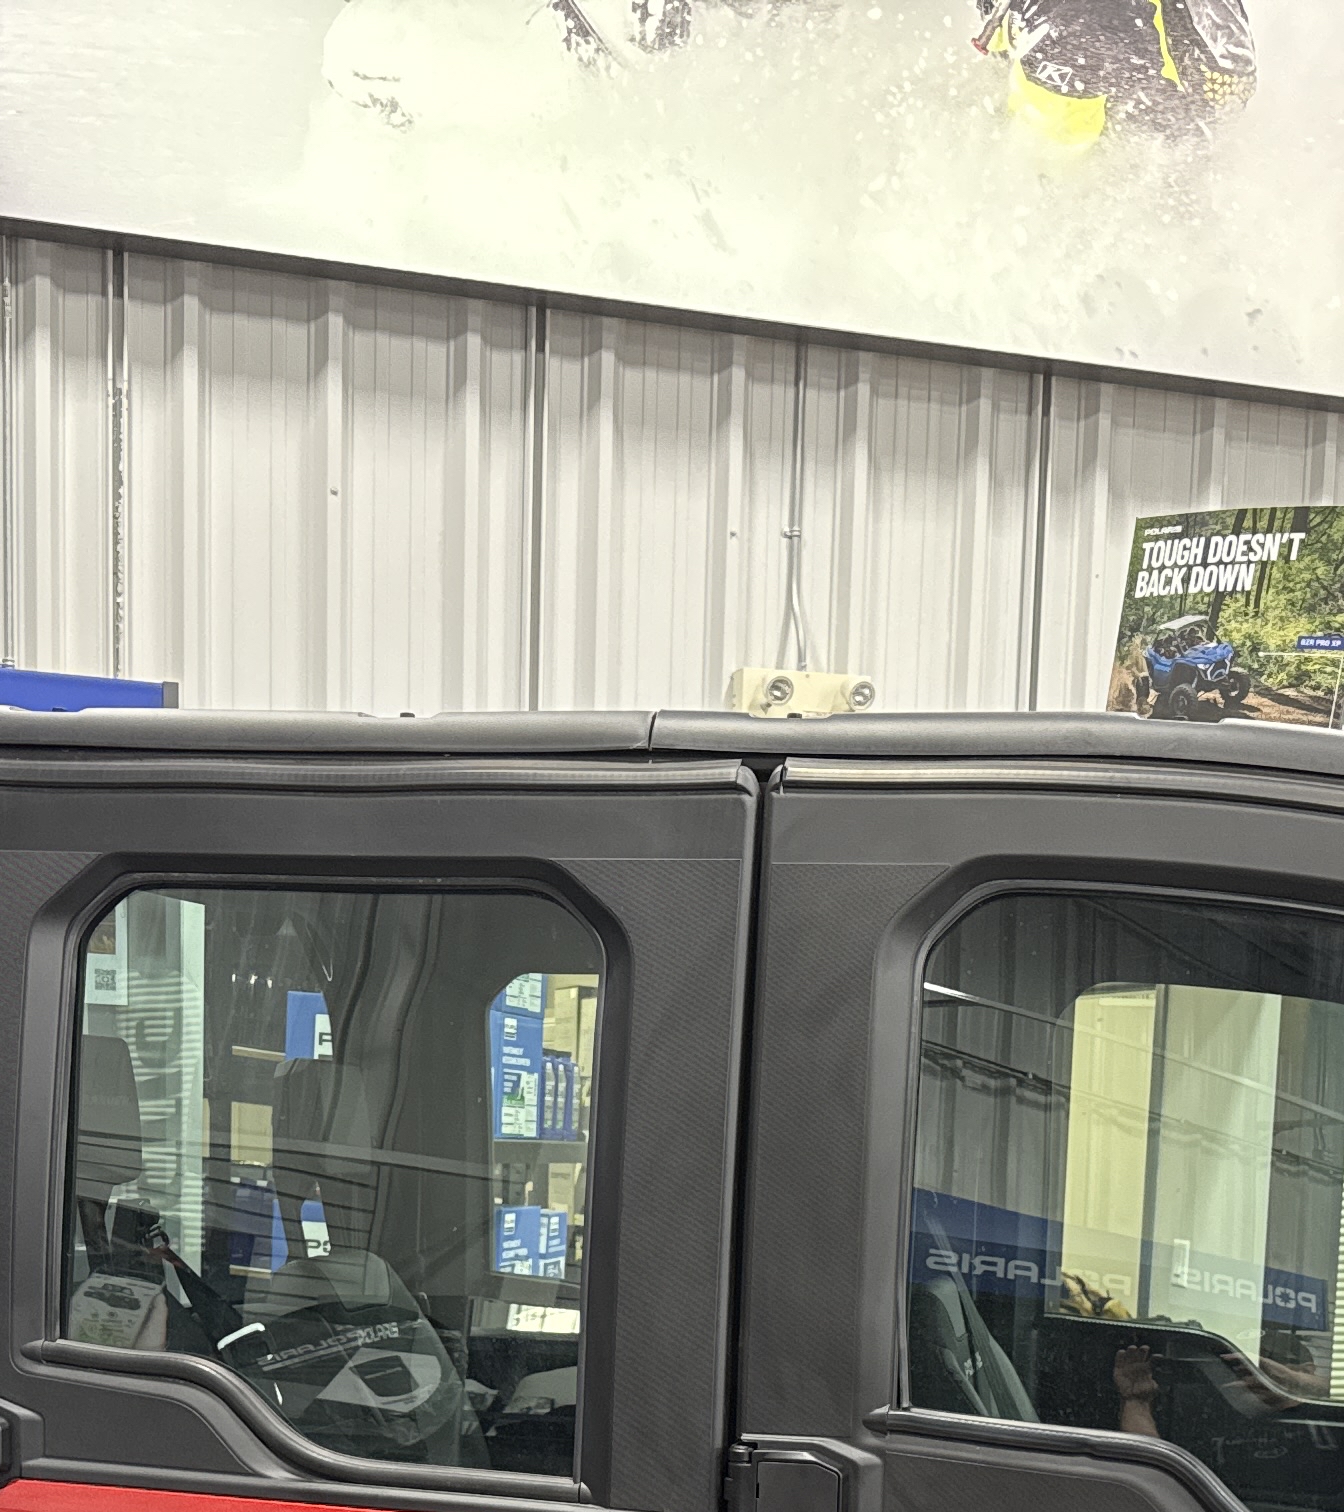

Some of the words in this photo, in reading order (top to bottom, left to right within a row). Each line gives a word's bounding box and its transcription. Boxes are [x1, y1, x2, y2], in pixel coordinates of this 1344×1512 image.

[1142, 536, 1205, 569] TOUGH
[1207, 533, 1306, 563] DOESN'T
[1135, 567, 1187, 598] BACK
[1188, 563, 1255, 593] DOWN
